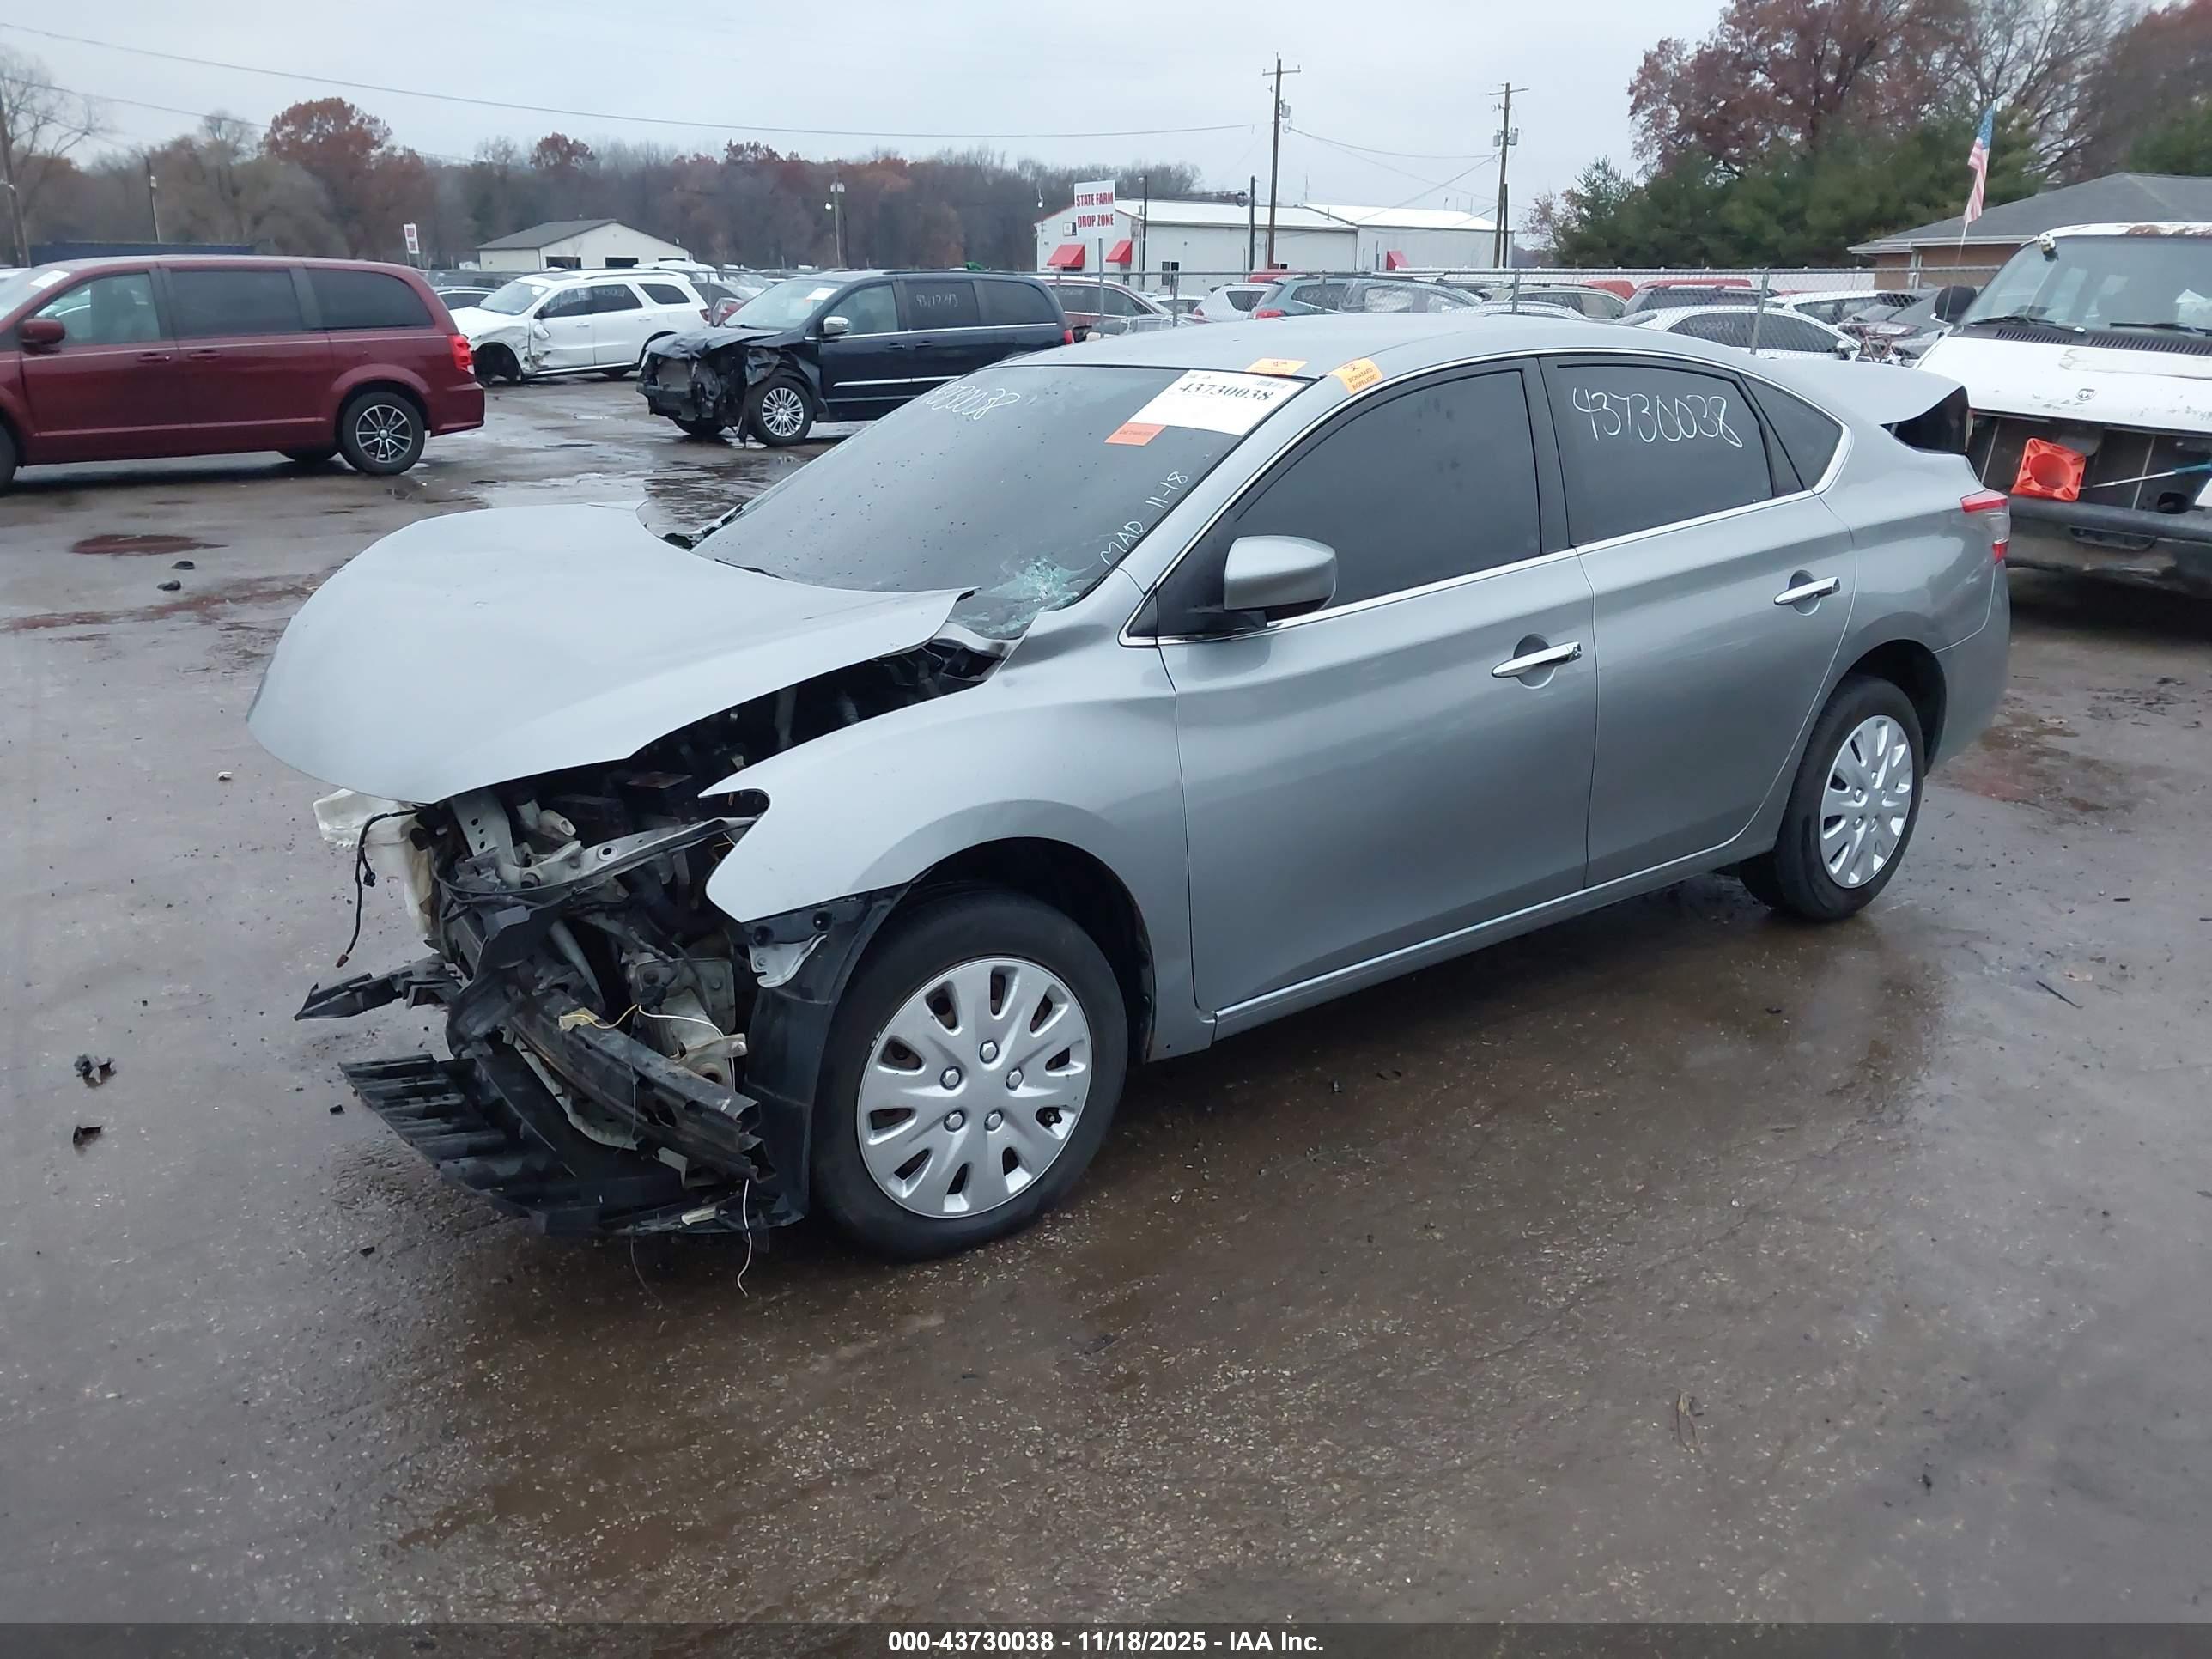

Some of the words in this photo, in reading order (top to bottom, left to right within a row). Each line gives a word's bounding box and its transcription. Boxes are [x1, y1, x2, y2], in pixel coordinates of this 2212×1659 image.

[1076, 194, 1095, 207] STATE
[1096, 192, 1114, 205] FARM
[1077, 215, 1096, 228] DROP
[1097, 214, 1114, 227] ZONE
[1180, 383, 1274, 401] 43730038
[1572, 386, 1743, 448] 43730038
[1099, 520, 1145, 566] MAD
[1145, 471, 1188, 508] 11-18
